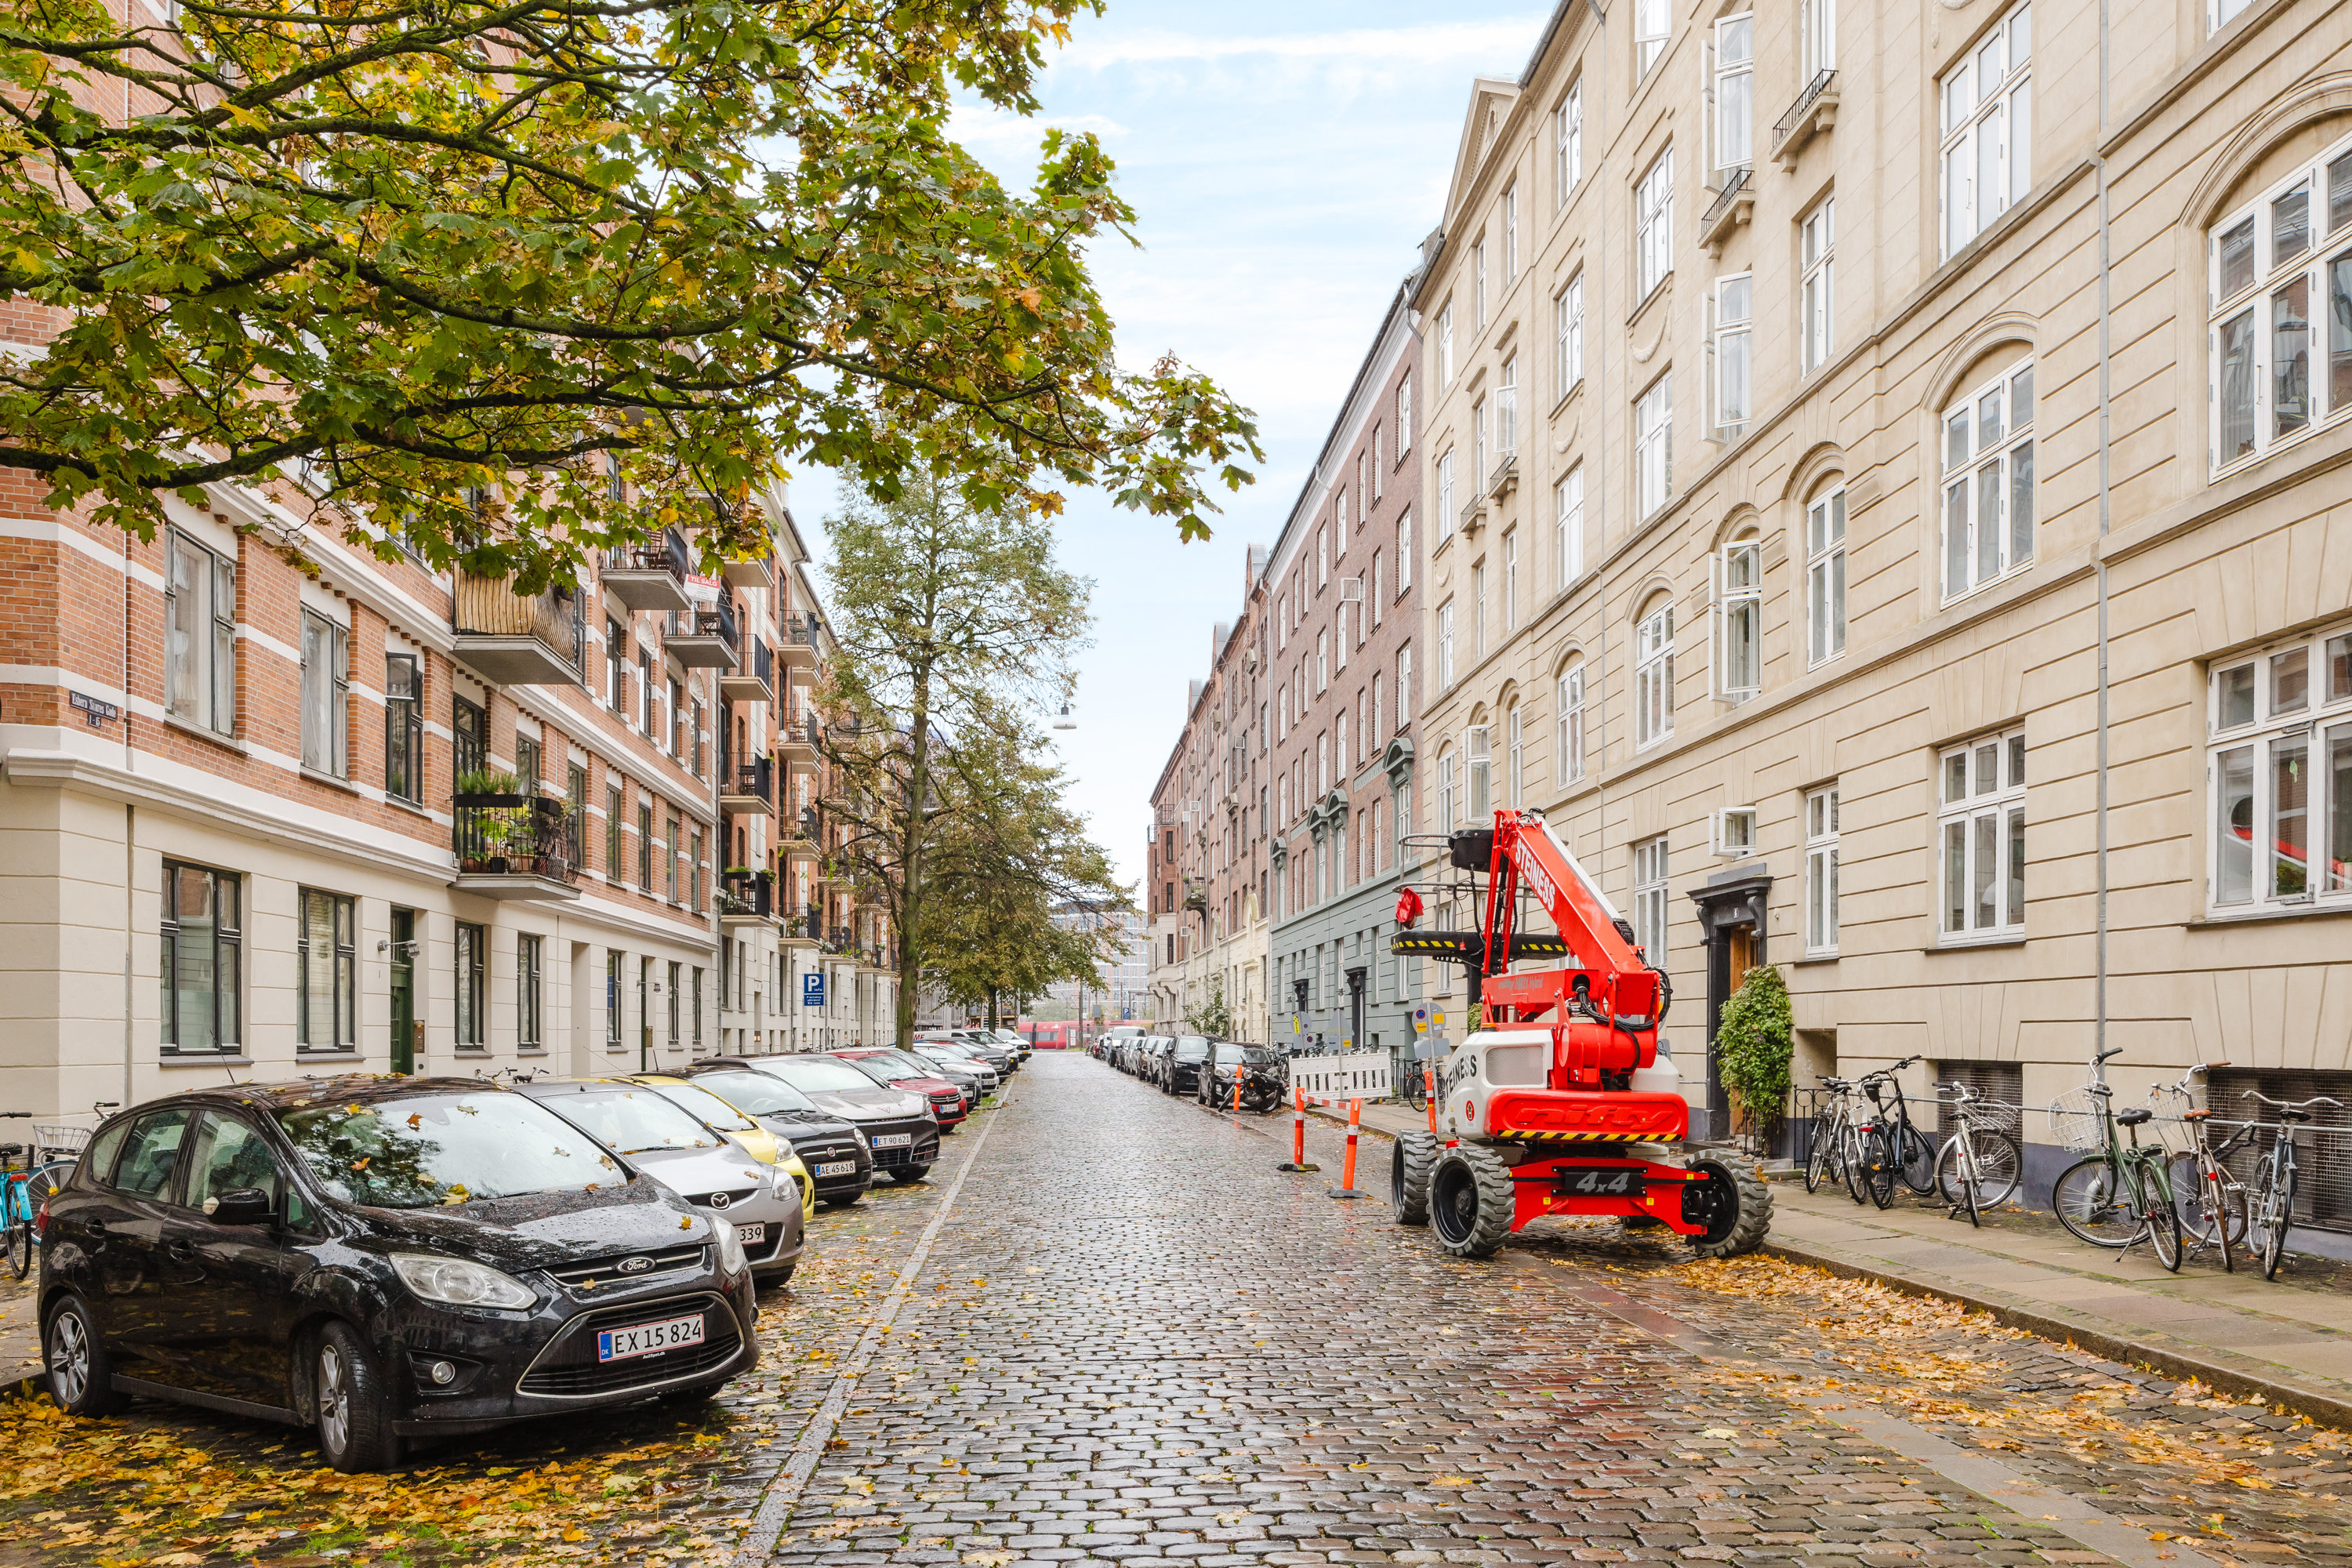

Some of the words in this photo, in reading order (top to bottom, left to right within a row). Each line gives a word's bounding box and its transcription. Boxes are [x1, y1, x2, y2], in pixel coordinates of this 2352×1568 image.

[72, 693, 88, 709] Esbern
[105, 705, 117, 718] Gade
[1515, 837, 1555, 912] STEINESS
[808, 975, 820, 992] P
[1445, 1054, 1477, 1098] TEINESS
[1515, 1104, 1674, 1131] nifty
[898, 1135, 910, 1144] 621
[821, 1166, 829, 1174] AE
[831, 1164, 840, 1174] 45
[840, 1163, 854, 1172] 618
[1576, 1171, 1630, 1193] 4x4
[739, 1227, 762, 1241] 339
[627, 1259, 648, 1271] Ford
[615, 1331, 639, 1354] EX
[644, 1327, 664, 1348] 15
[670, 1319, 701, 1343] 824
